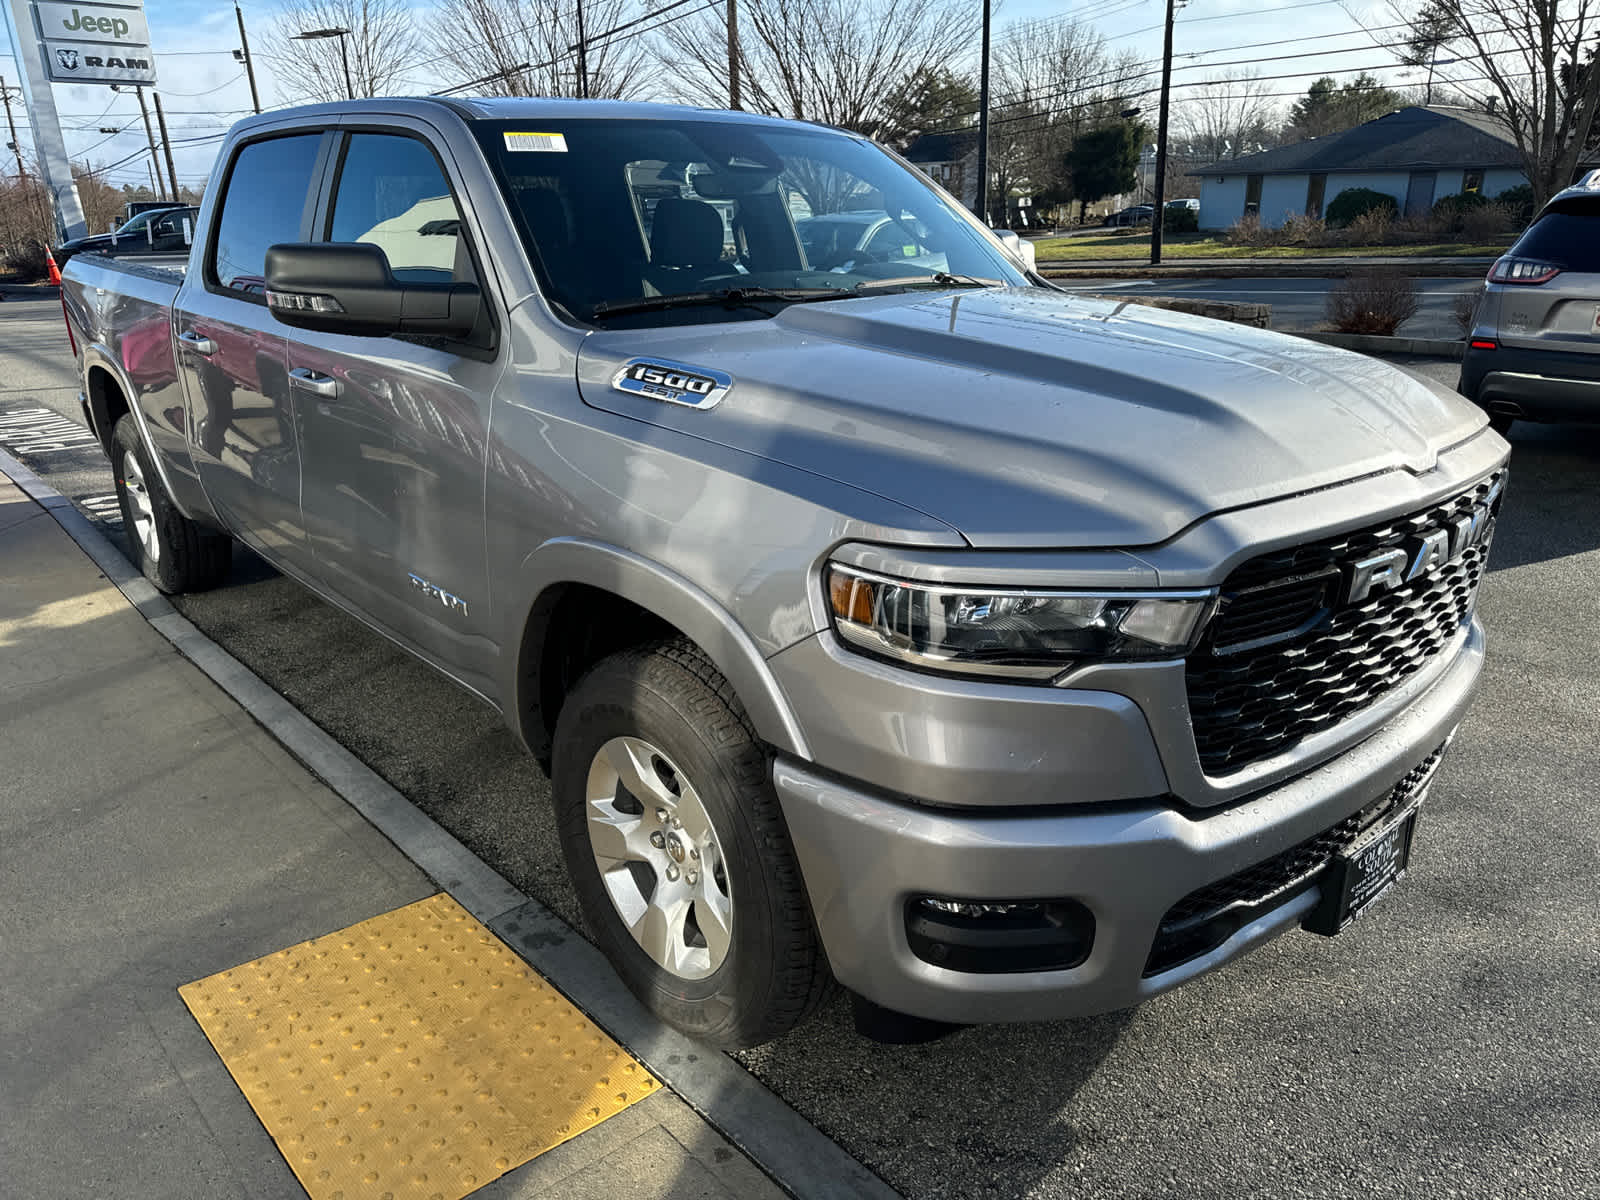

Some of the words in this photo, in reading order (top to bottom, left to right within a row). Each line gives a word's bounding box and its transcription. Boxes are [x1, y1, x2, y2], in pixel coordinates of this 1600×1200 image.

[63, 8, 129, 38] Jeep
[84, 56, 149, 70] RAM
[634, 366, 713, 395] 1500
[642, 384, 686, 400] SST
[1348, 504, 1486, 603] RAM
